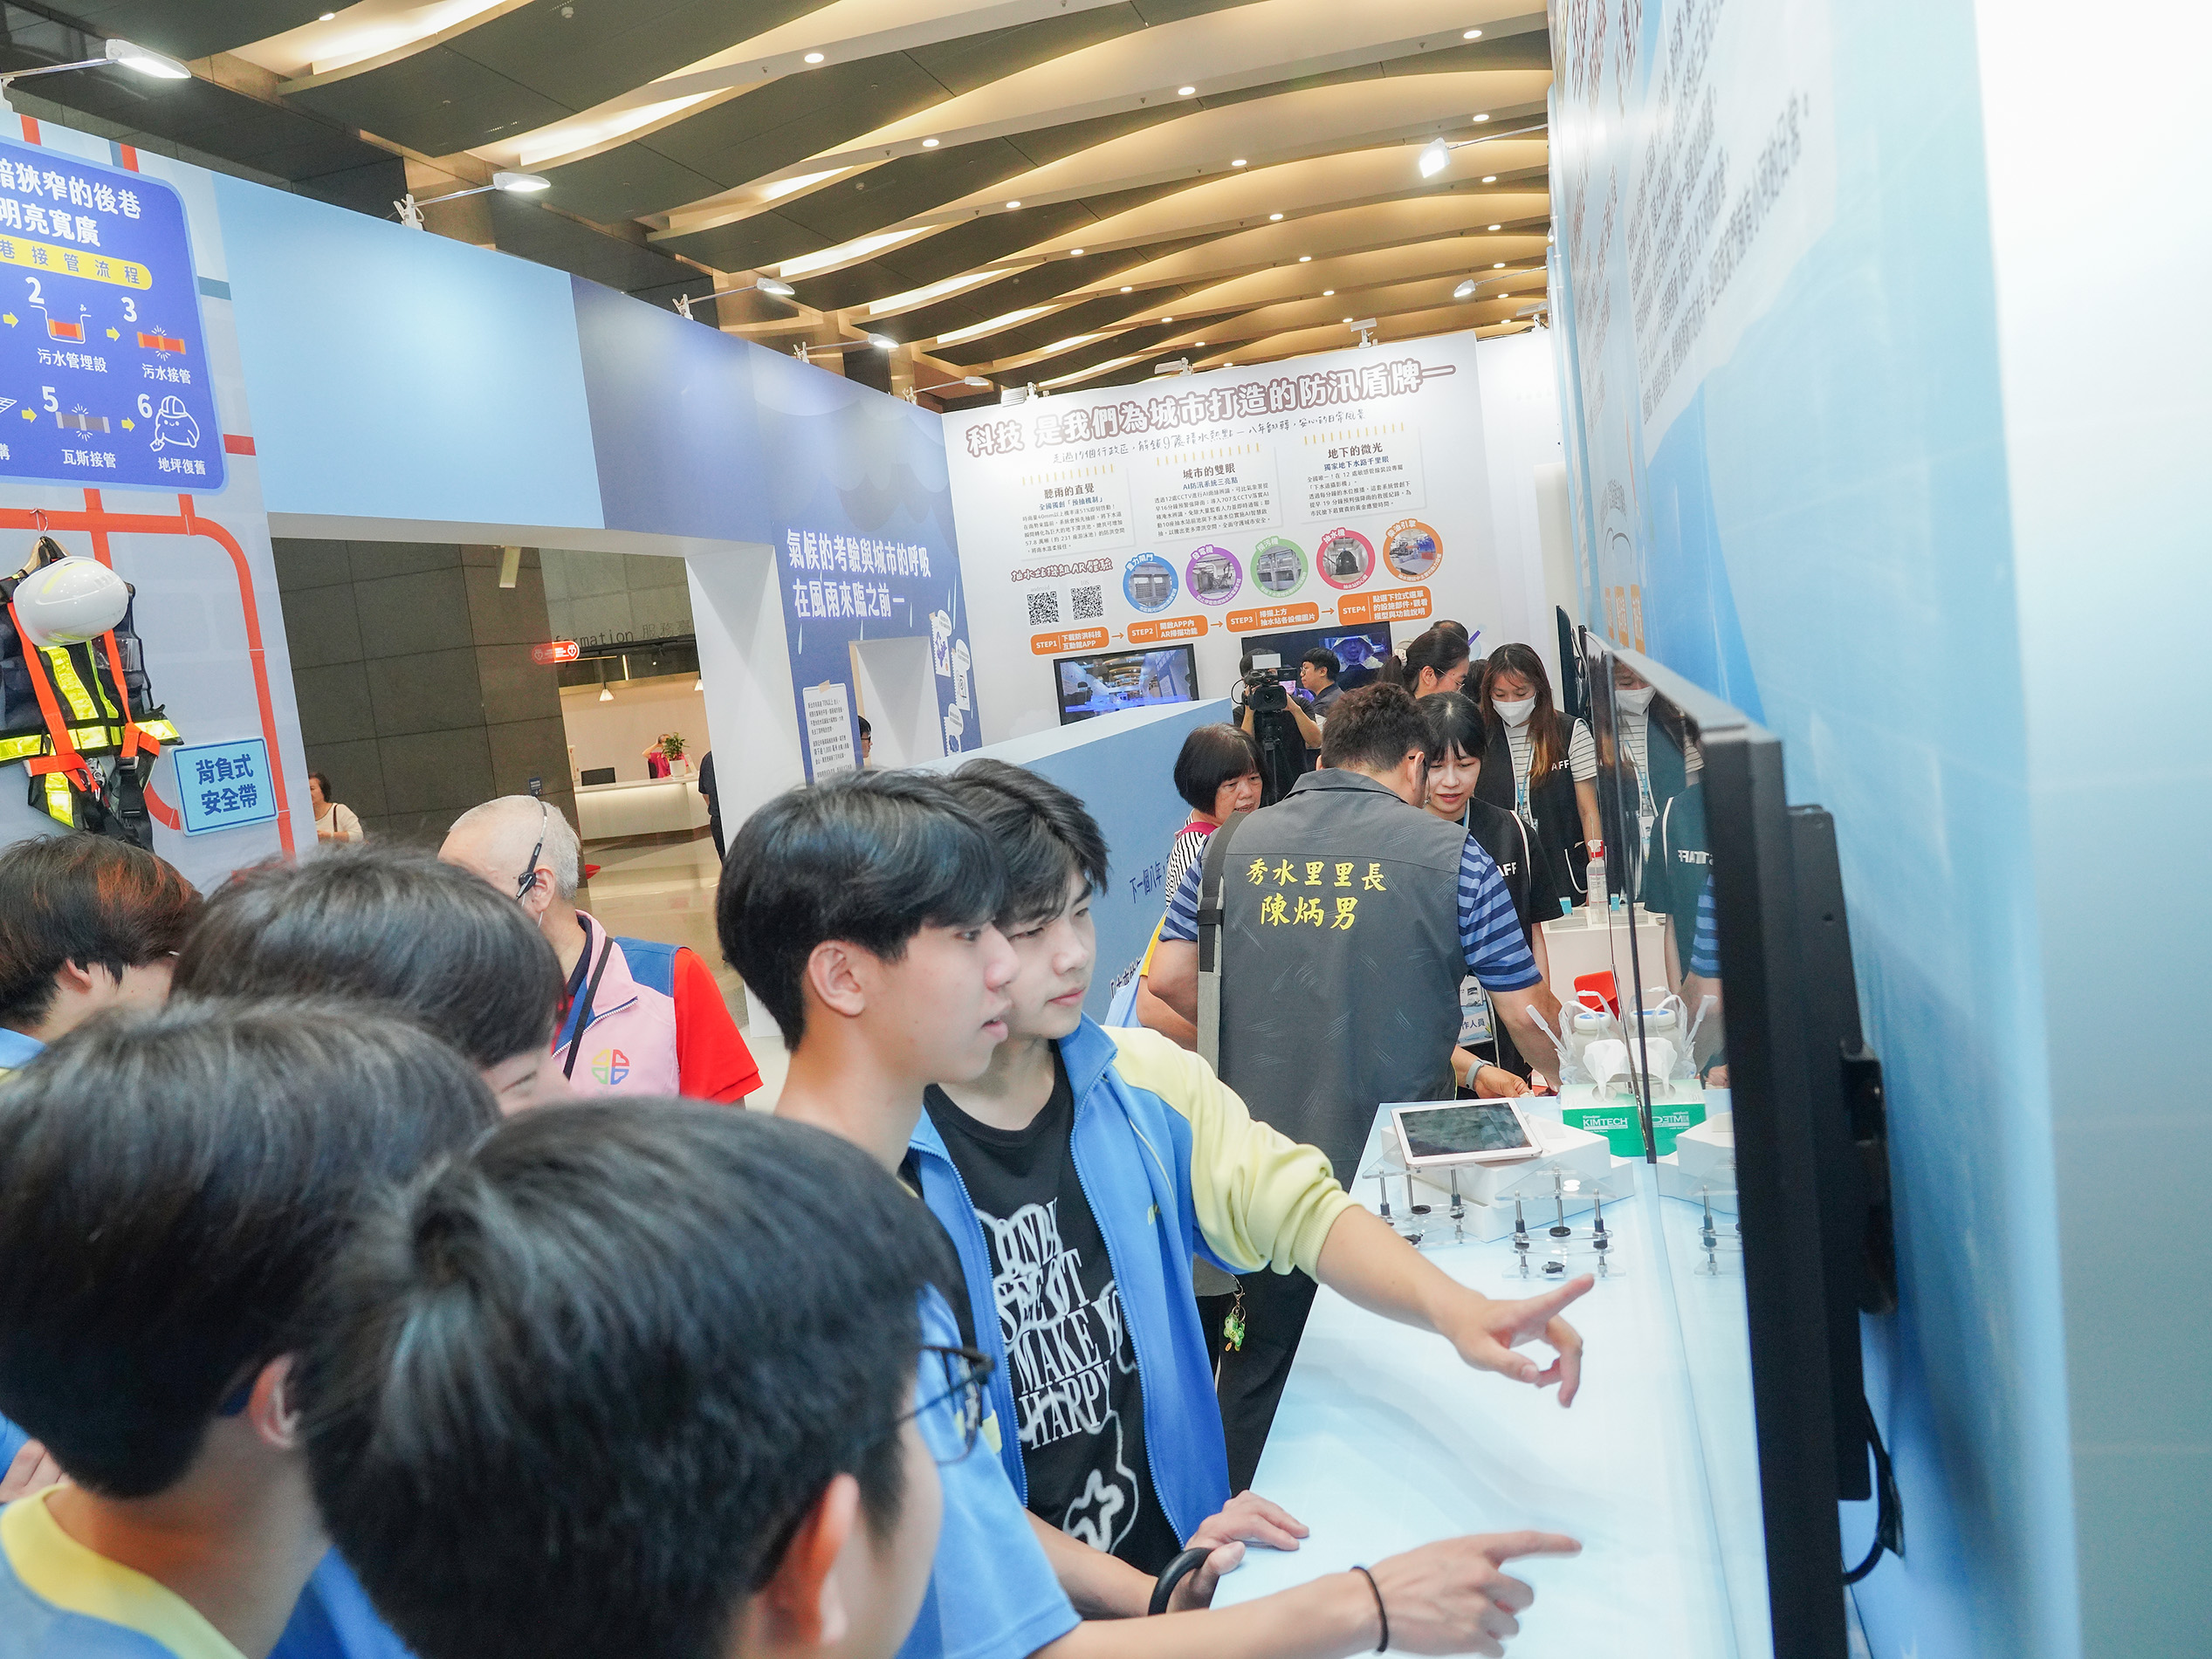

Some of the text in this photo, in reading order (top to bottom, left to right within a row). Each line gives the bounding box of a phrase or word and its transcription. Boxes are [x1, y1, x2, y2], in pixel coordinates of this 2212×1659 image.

[0, 197, 101, 248] 明亮寬廣
[25, 277, 45, 305] 2
[121, 297, 138, 323] 3
[37, 347, 108, 374] 污水管埋設
[141, 363, 192, 385] 污水接管
[42, 386, 59, 413] 5
[137, 393, 154, 419] 6
[966, 420, 1025, 458] 科技
[1328, 442, 1383, 459] 地下的微光
[62, 449, 116, 470] 瓦斯接管
[158, 457, 206, 476] 地坪復舊
[1183, 463, 1236, 479] 城市的雙眼
[1324, 456, 1390, 471] 獨家地下水路千里眼
[1044, 483, 1095, 499] 聽雨的直覺
[1183, 476, 1239, 490] AI防汛系統三亮點
[787, 528, 931, 578] 氣候的考驗與城市的呼吸
[1231, 616, 1254, 625] STEP3
[1260, 608, 1288, 618] 掃描上方
[1343, 606, 1366, 614] STEP4
[1061, 631, 1102, 641] 下載防洪科技
[1161, 627, 1198, 638] AR掃描功能
[196, 753, 253, 785] 背負式
[201, 784, 258, 816] 安全帶
[1246, 858, 1387, 892] 秀水里里長
[1261, 896, 1358, 930] 陳炳男
[1583, 1118, 1628, 1127] KIMTECH
[1014, 1309, 1104, 1395] MAKE
[1018, 1360, 1114, 1450] HAPPY
